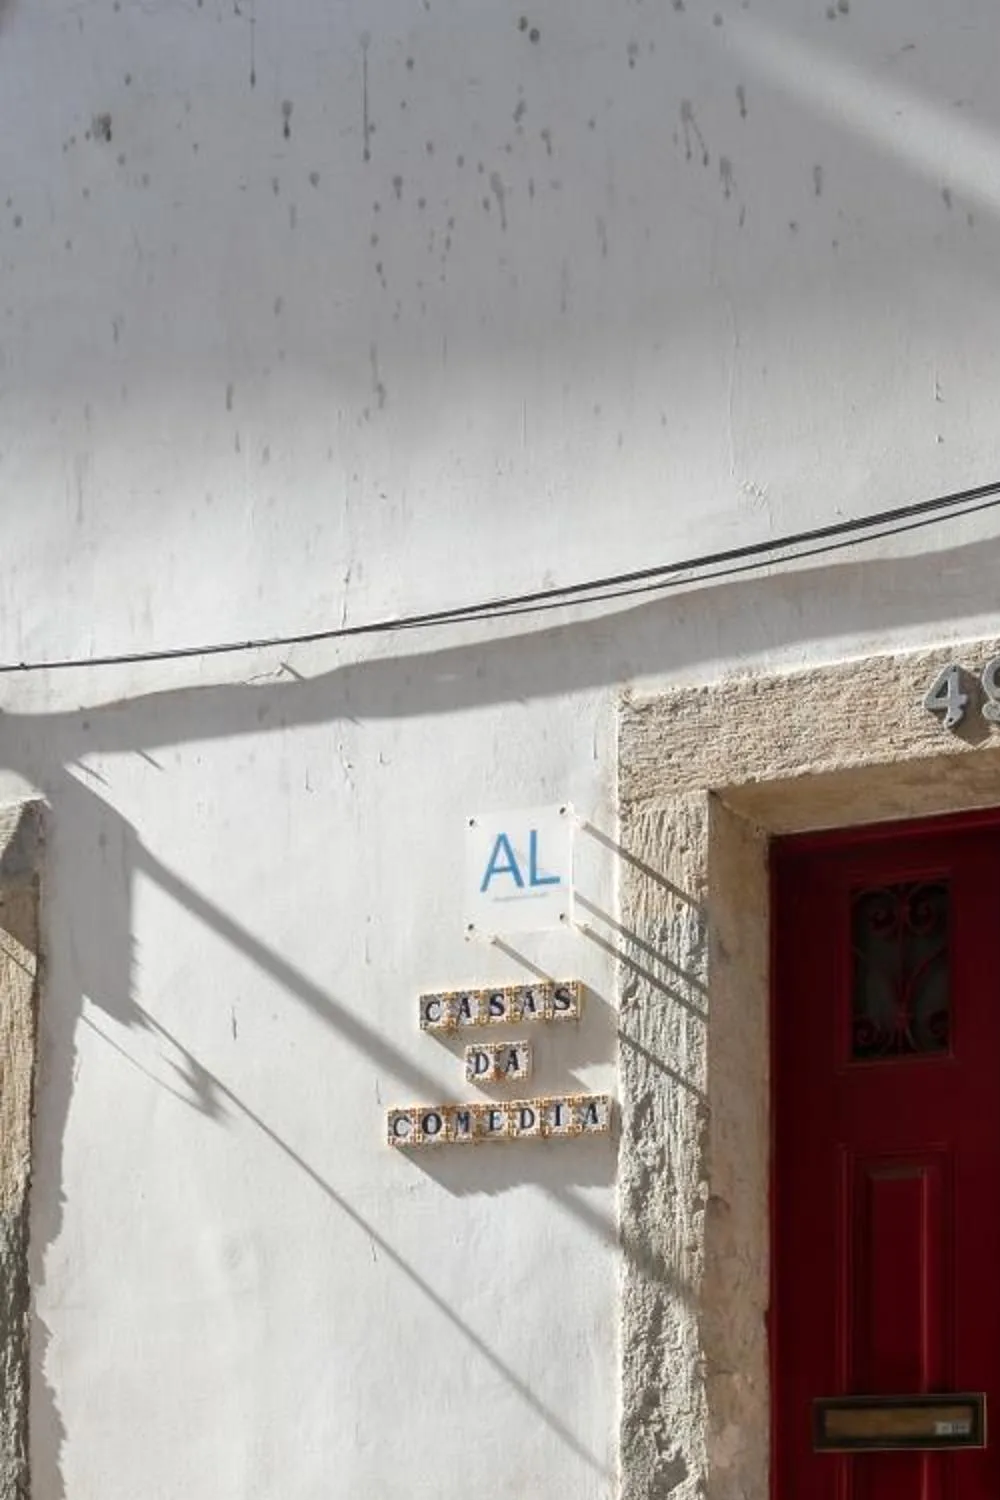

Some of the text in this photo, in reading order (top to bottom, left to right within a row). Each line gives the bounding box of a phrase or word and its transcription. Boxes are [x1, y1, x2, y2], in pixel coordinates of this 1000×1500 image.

[480, 829, 560, 893] AL
[425, 987, 572, 1022] CASAS
[474, 1049, 521, 1075] DA
[393, 1102, 600, 1137] COMEDIA
